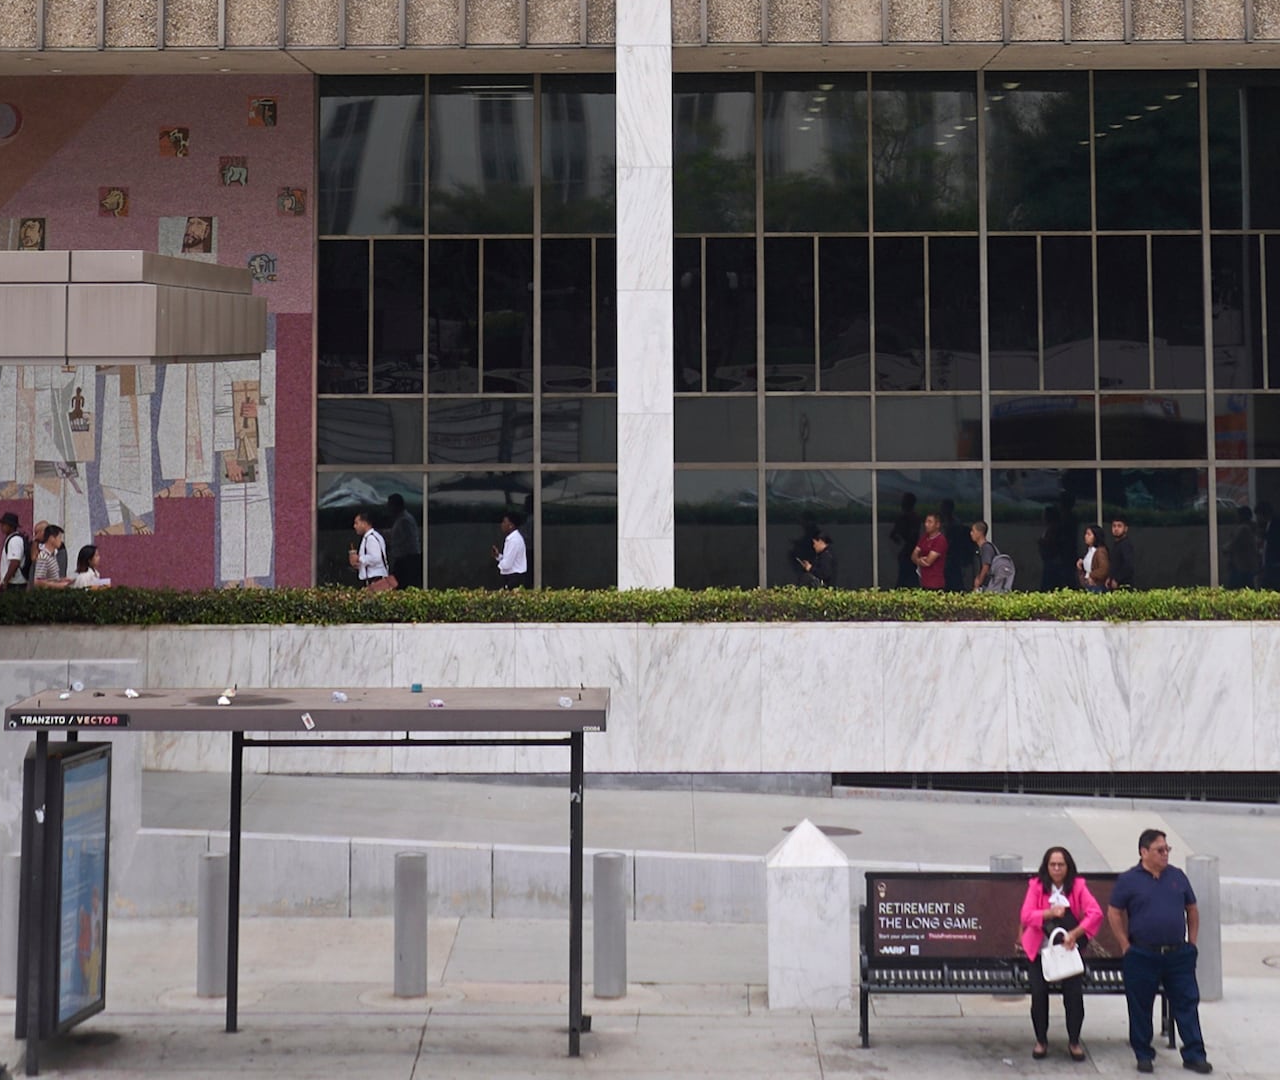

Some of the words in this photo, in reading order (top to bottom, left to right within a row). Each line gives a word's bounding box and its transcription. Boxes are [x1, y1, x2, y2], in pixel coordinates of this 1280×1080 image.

[21, 715, 66, 725] TRANZITO
[76, 715, 119, 725] VECTOR
[878, 902, 951, 915] RETIREMENT
[953, 902, 966, 915] IS
[878, 916, 902, 929] THE
[905, 916, 940, 929] LONG
[943, 916, 982, 930] GAME.
